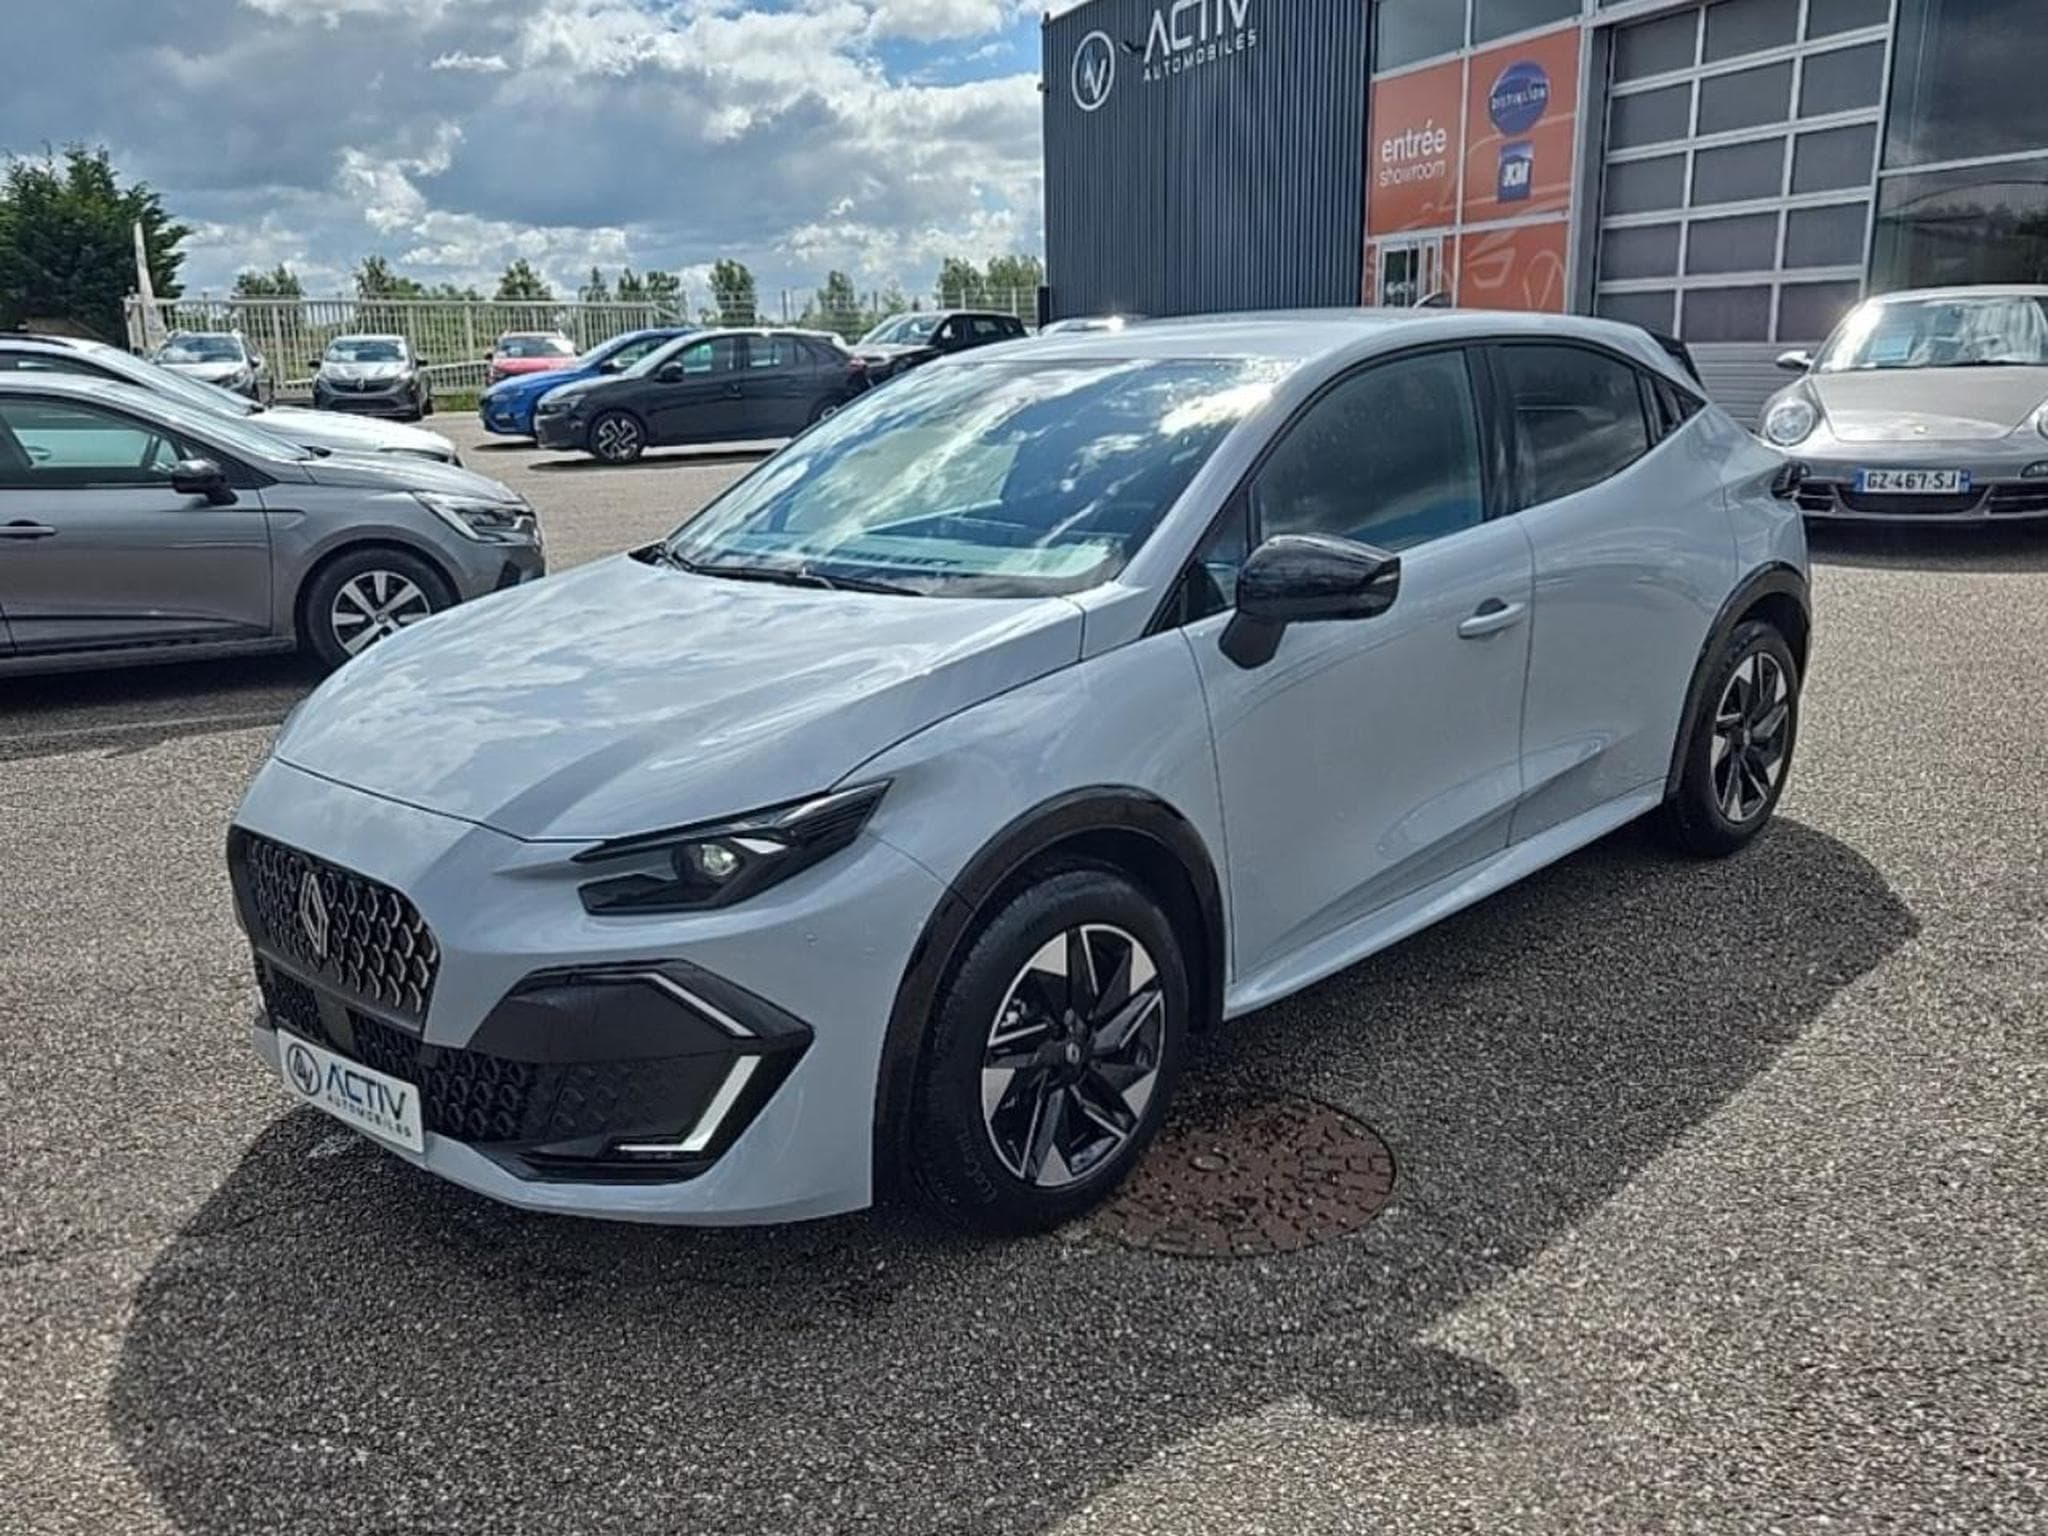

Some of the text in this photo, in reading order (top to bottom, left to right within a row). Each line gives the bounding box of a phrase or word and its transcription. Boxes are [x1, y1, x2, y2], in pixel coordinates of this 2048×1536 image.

[1143, 28, 1257, 81] AUTOMOBILES
[1381, 118, 1448, 163] entrée
[1379, 159, 1446, 187] showroom
[327, 1062, 406, 1121] ACTIV
